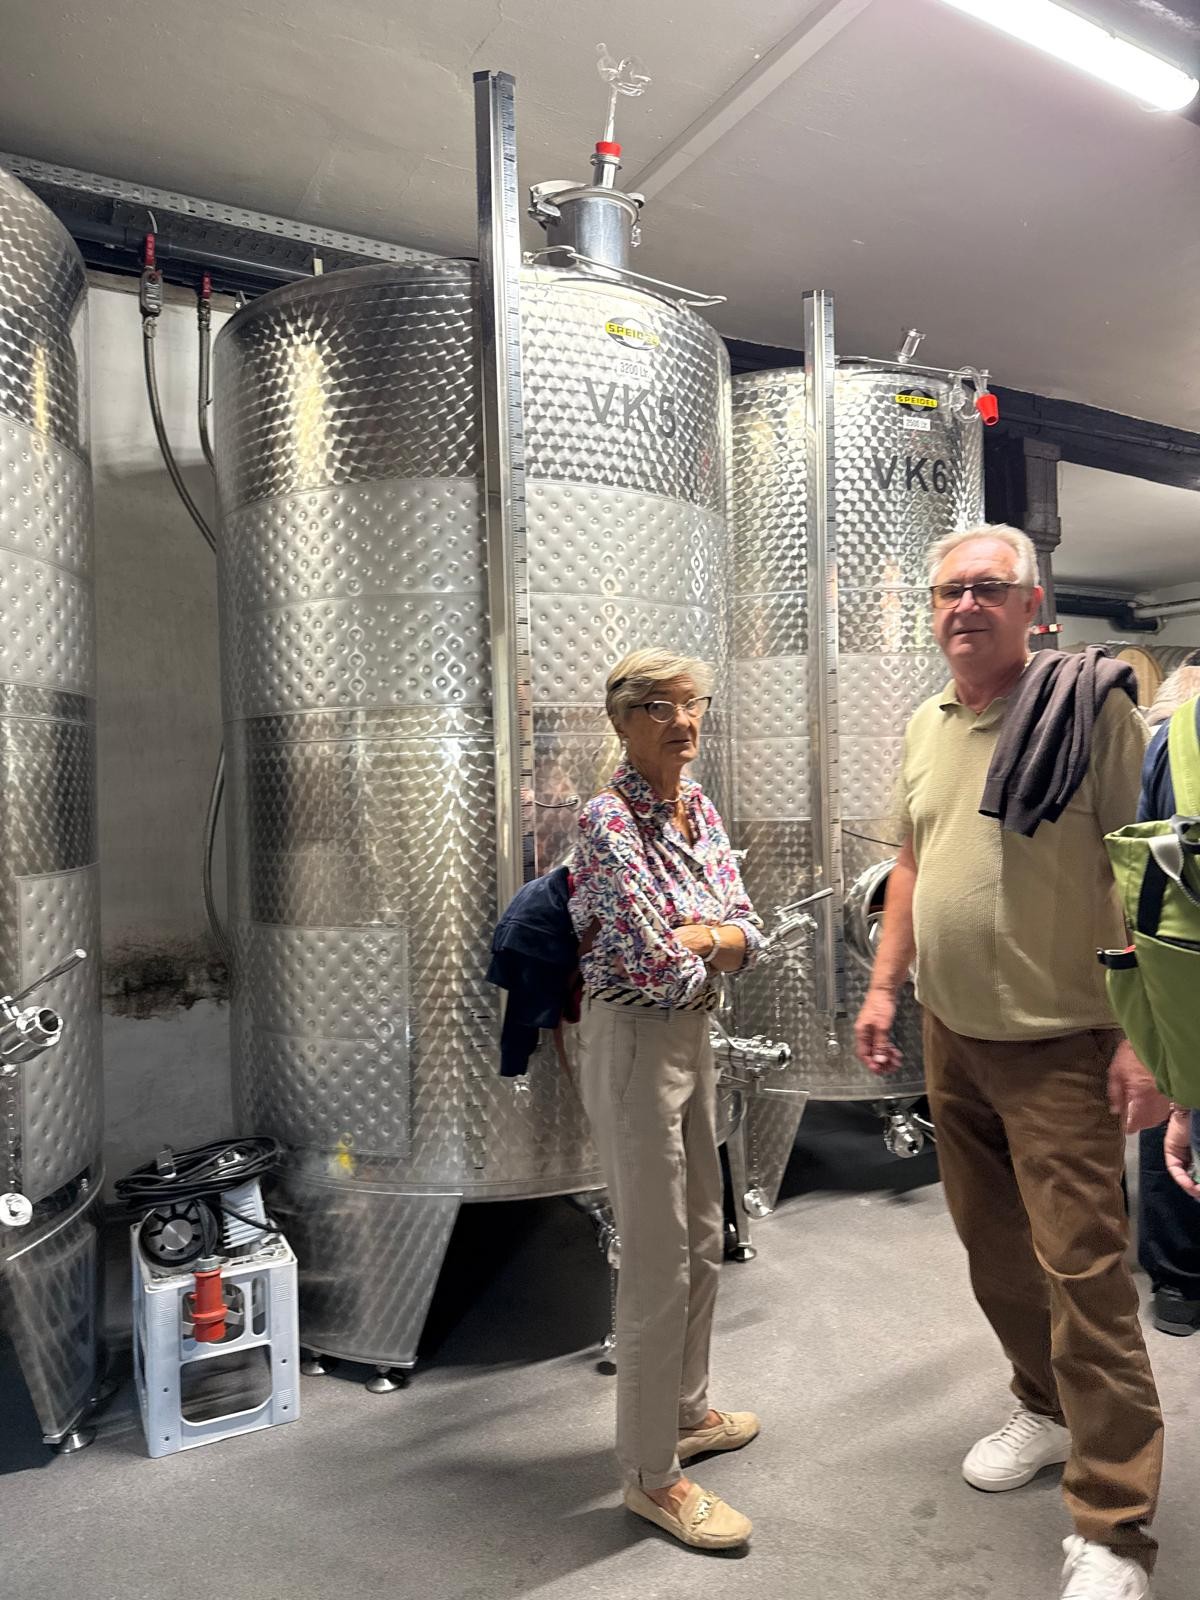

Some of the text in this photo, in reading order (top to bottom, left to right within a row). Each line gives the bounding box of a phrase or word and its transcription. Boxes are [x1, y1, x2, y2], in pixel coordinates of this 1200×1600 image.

[583, 376, 677, 439] VK5
[897, 395, 935, 406] SPEIDEL
[872, 455, 948, 494] VK6
